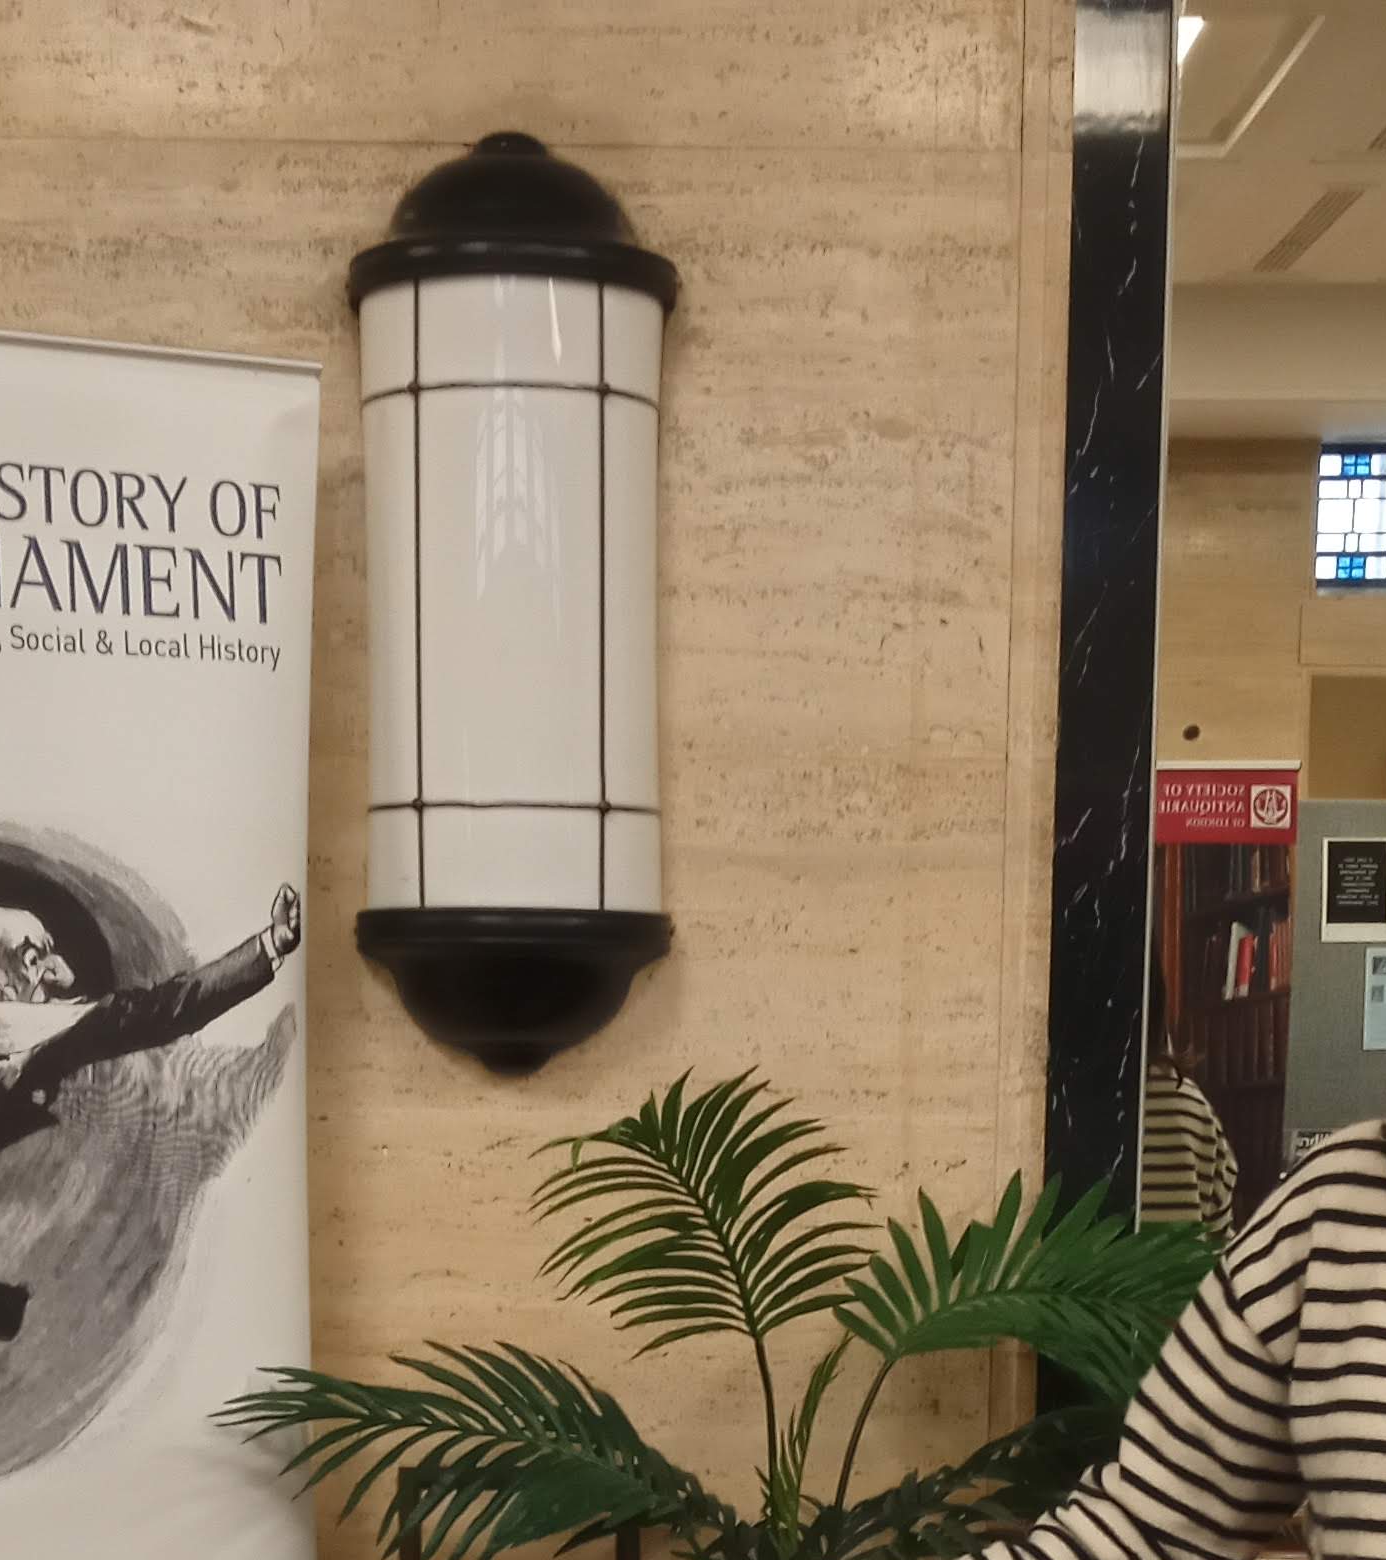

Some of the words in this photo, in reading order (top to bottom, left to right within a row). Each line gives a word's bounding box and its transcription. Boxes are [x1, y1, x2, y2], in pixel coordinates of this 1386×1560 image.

[209, 480, 281, 540] OF
[10, 624, 86, 654] Social
[95, 629, 114, 656] &
[124, 630, 191, 659] Local
[199, 632, 281, 672] History
